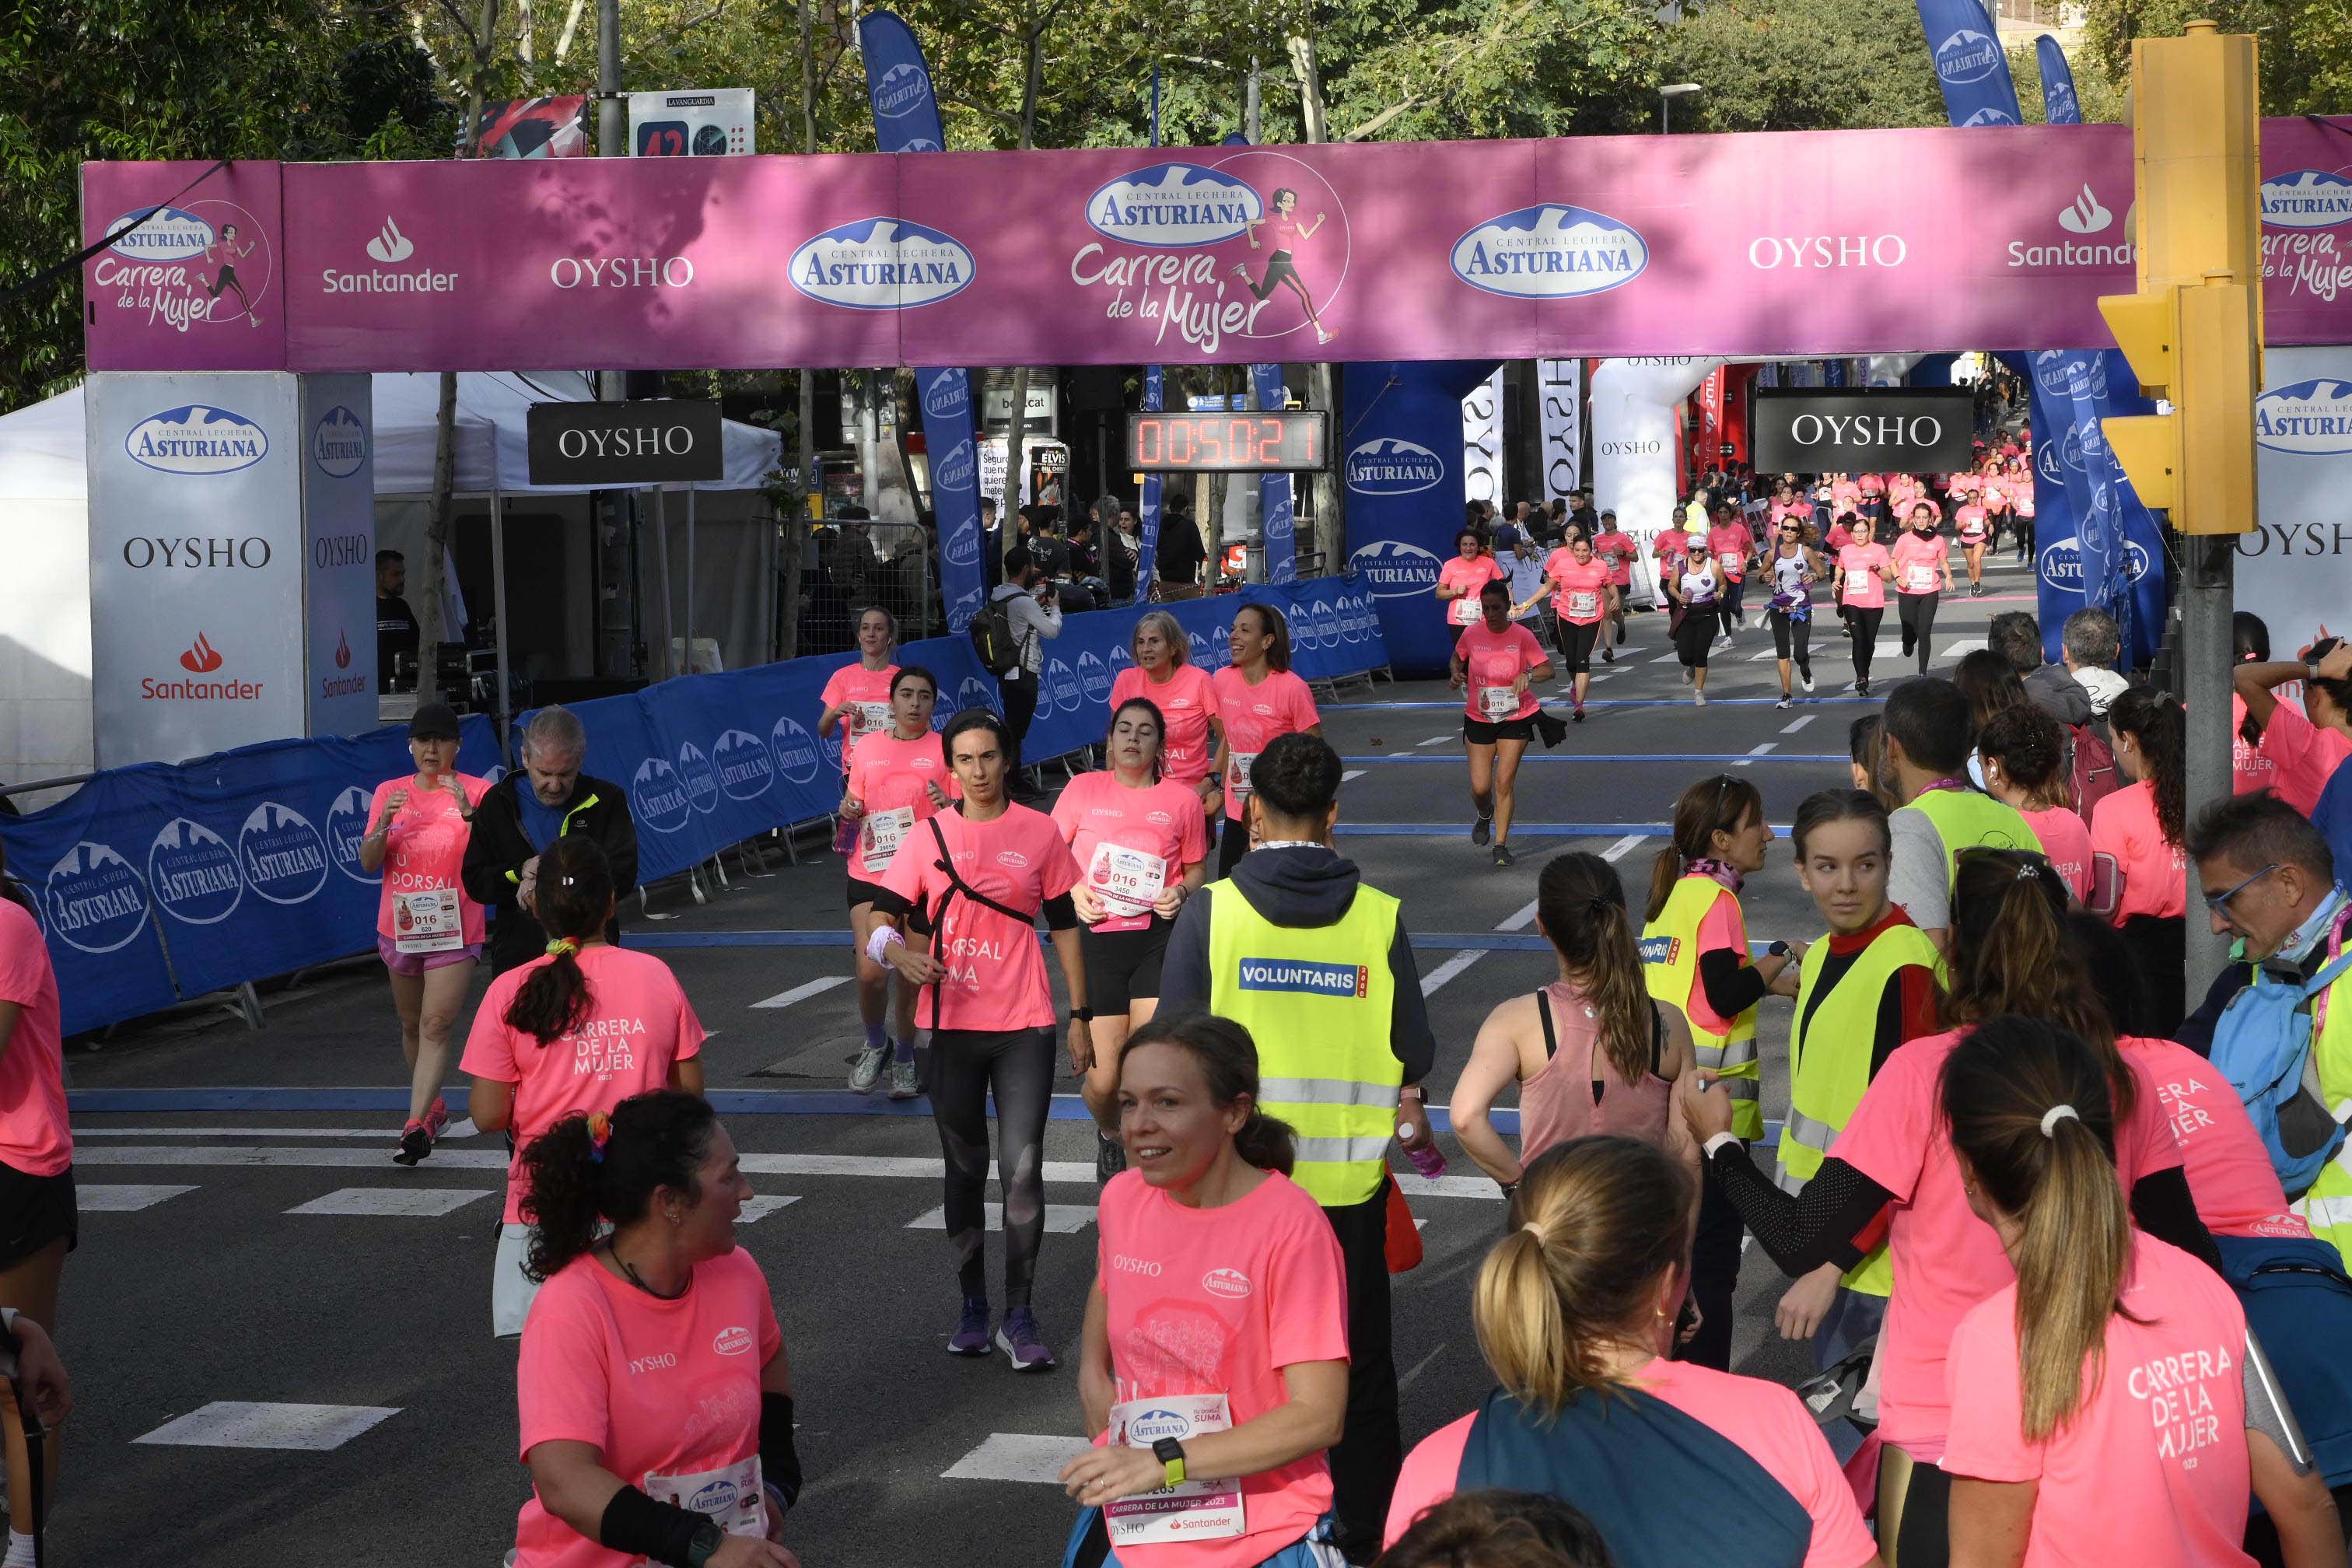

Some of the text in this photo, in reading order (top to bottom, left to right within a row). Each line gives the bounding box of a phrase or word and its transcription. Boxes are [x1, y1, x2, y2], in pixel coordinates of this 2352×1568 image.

[1127, 191, 1244, 201] CENTRAL LECHERA
[2261, 193, 2352, 214] ASTURIAN
[1100, 195, 1248, 226] ASTURIANA
[896, 249, 955, 257] LECHERA
[1496, 236, 1626, 247] CENTRAL LECHERA
[1749, 234, 1906, 269] OYSHO
[2262, 233, 2336, 255] arrera
[1072, 243, 1216, 286] Carrera
[1466, 240, 1633, 275] ASTURIANA
[2008, 240, 2137, 268] Santand
[94, 257, 187, 287] Carrera
[551, 257, 694, 288] OYSHO
[803, 252, 961, 285] ASTURIANA
[2280, 251, 2352, 302] la Muje
[323, 267, 459, 294] Santander
[118, 284, 221, 333] de la Mujer
[1107, 285, 1271, 354] de la Mujer
[2277, 404, 2330, 414] CENTRAL
[1791, 414, 1941, 448] OYSHO
[2256, 407, 2352, 437] ASTURI
[137, 431, 258, 457] ASTURIANA
[318, 432, 363, 460] ASTURIANA
[558, 425, 695, 460] OYSHO
[1601, 441, 1661, 456] OYSHO
[1041, 453, 1066, 464] ELVIS
[984, 467, 996, 476] que
[1349, 460, 1437, 482] ASTURIANA
[124, 537, 271, 569] OYSHO
[315, 534, 368, 569] OYSHO
[1366, 568, 1437, 583] TURIANA
[142, 677, 264, 700] Santander
[322, 673, 366, 698] Santander
[776, 746, 816, 769] ASTURIANA
[2233, 759, 2272, 770] MUJER
[2235, 749, 2264, 759] DE L
[716, 756, 772, 786] ASTURIANA
[1091, 808, 1122, 817] OYSHO
[877, 833, 897, 844] 016
[246, 845, 324, 884] ASTURIANA
[158, 863, 240, 903] ASTURIANA
[1112, 873, 1137, 887] 016
[1114, 885, 1130, 894] 3450
[54, 884, 143, 931] ASTURIANA
[415, 915, 437, 925] 016
[1243, 966, 1353, 989] VOLUNTARIS
[561, 1017, 646, 1042] ARRERA
[577, 1037, 630, 1057] DE LA
[574, 1053, 635, 1076] MUJER
[1114, 1255, 1162, 1277] OYSHO
[1206, 1276, 1248, 1293] ASTURIANA
[718, 1337, 751, 1353] ASTURIANA
[2128, 1346, 2232, 1400] CARRERA
[2152, 1383, 2214, 1428] DE LA
[1194, 1413, 1222, 1423] SUMA
[1134, 1423, 1185, 1437] ASTURIANA
[693, 1491, 737, 1510] ASTURIANA
[1111, 1497, 1226, 1514] CARRERA DE LA MUJER 2023
[1182, 1517, 1231, 1529] Santander
